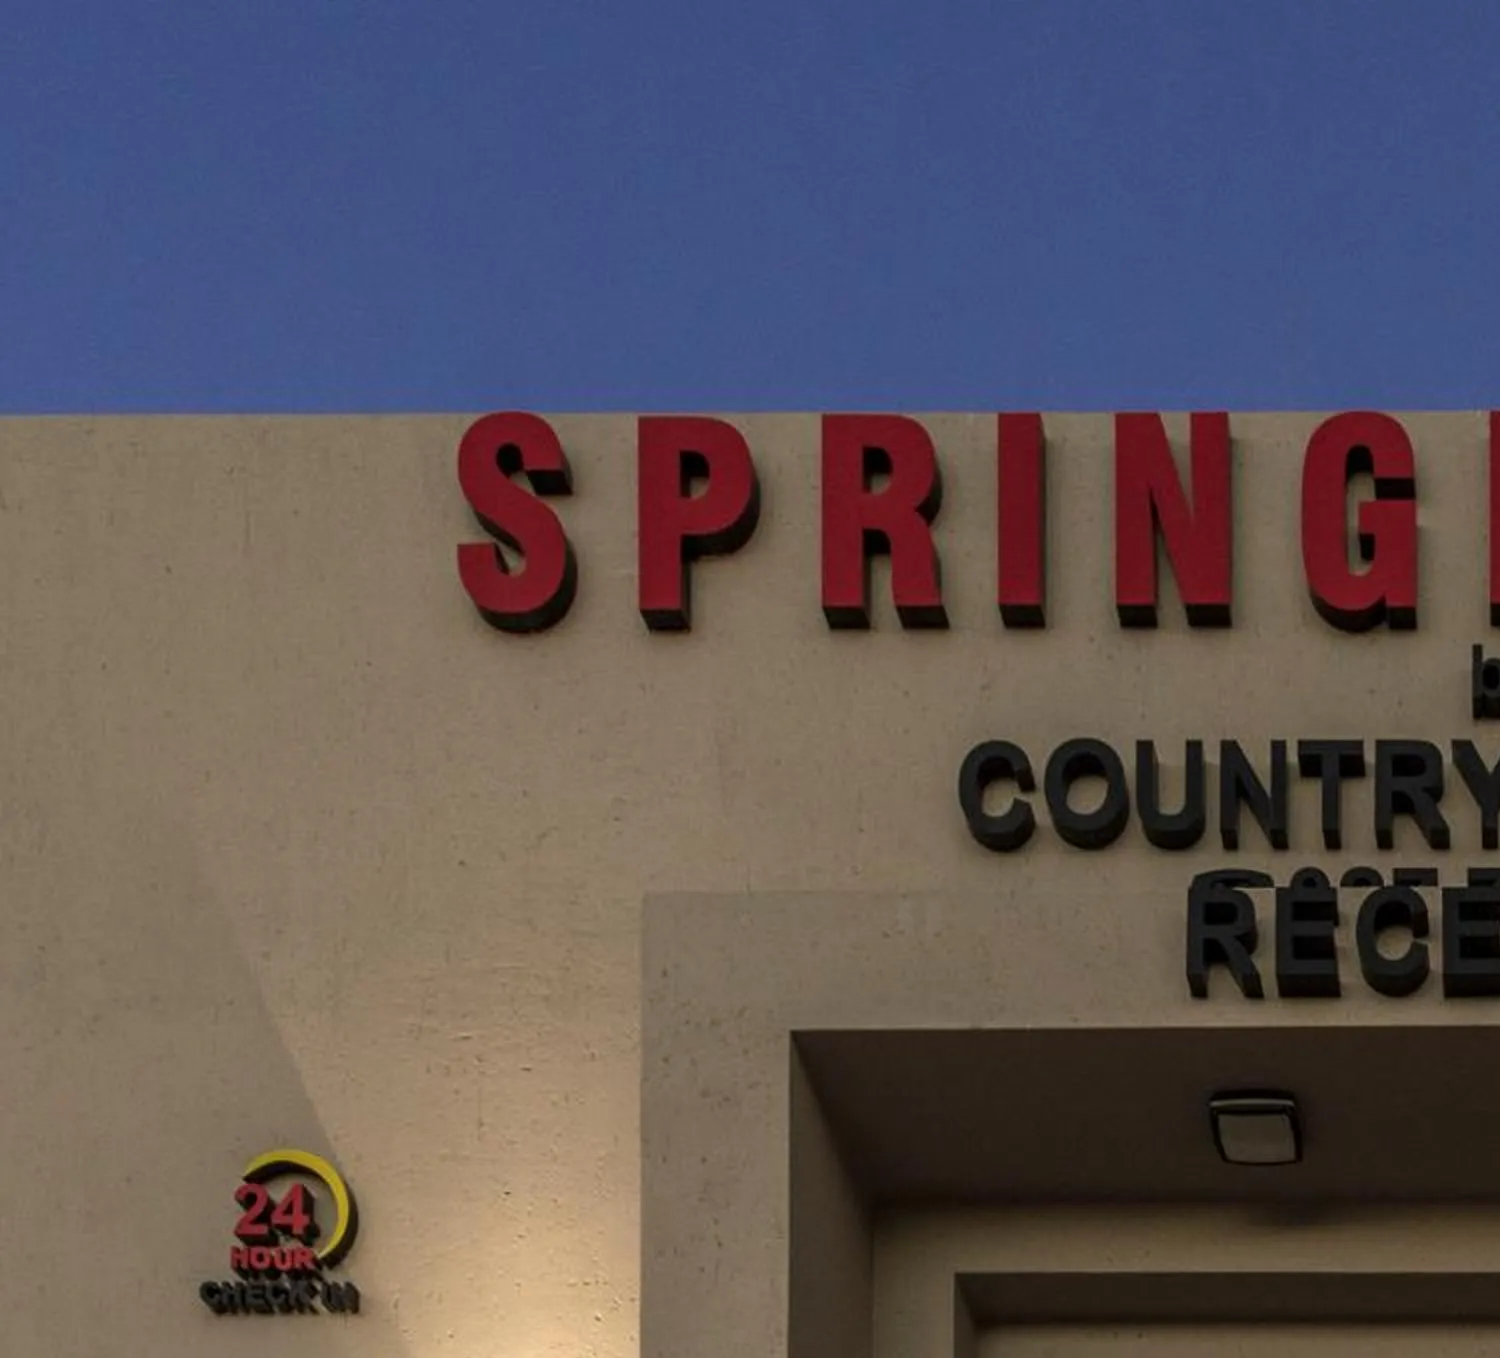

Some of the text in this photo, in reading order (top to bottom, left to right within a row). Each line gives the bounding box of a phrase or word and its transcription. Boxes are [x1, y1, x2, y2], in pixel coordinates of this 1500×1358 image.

[234, 1182, 317, 1242] 24
[230, 1246, 316, 1275] HOUR
[199, 1280, 361, 1315] CHECK IN
